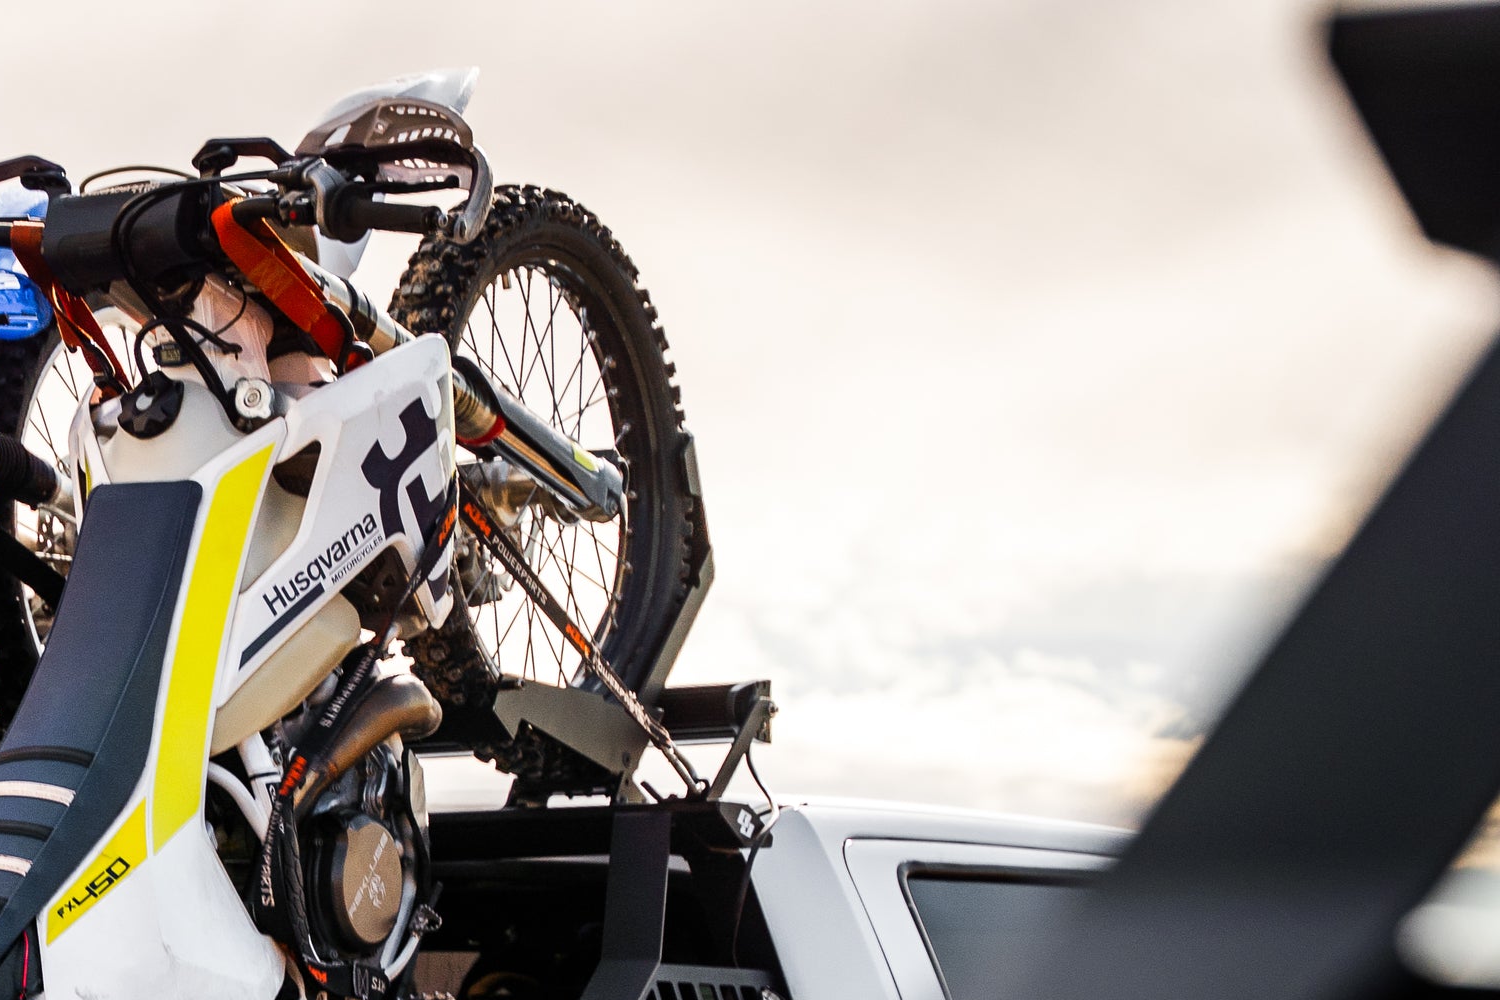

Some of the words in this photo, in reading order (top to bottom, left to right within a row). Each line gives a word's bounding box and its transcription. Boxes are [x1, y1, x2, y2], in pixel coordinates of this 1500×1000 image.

[263, 513, 378, 617] Husqvarna
[331, 535, 384, 585] MOTORCYCLES
[491, 534, 548, 606] POWERPARTS
